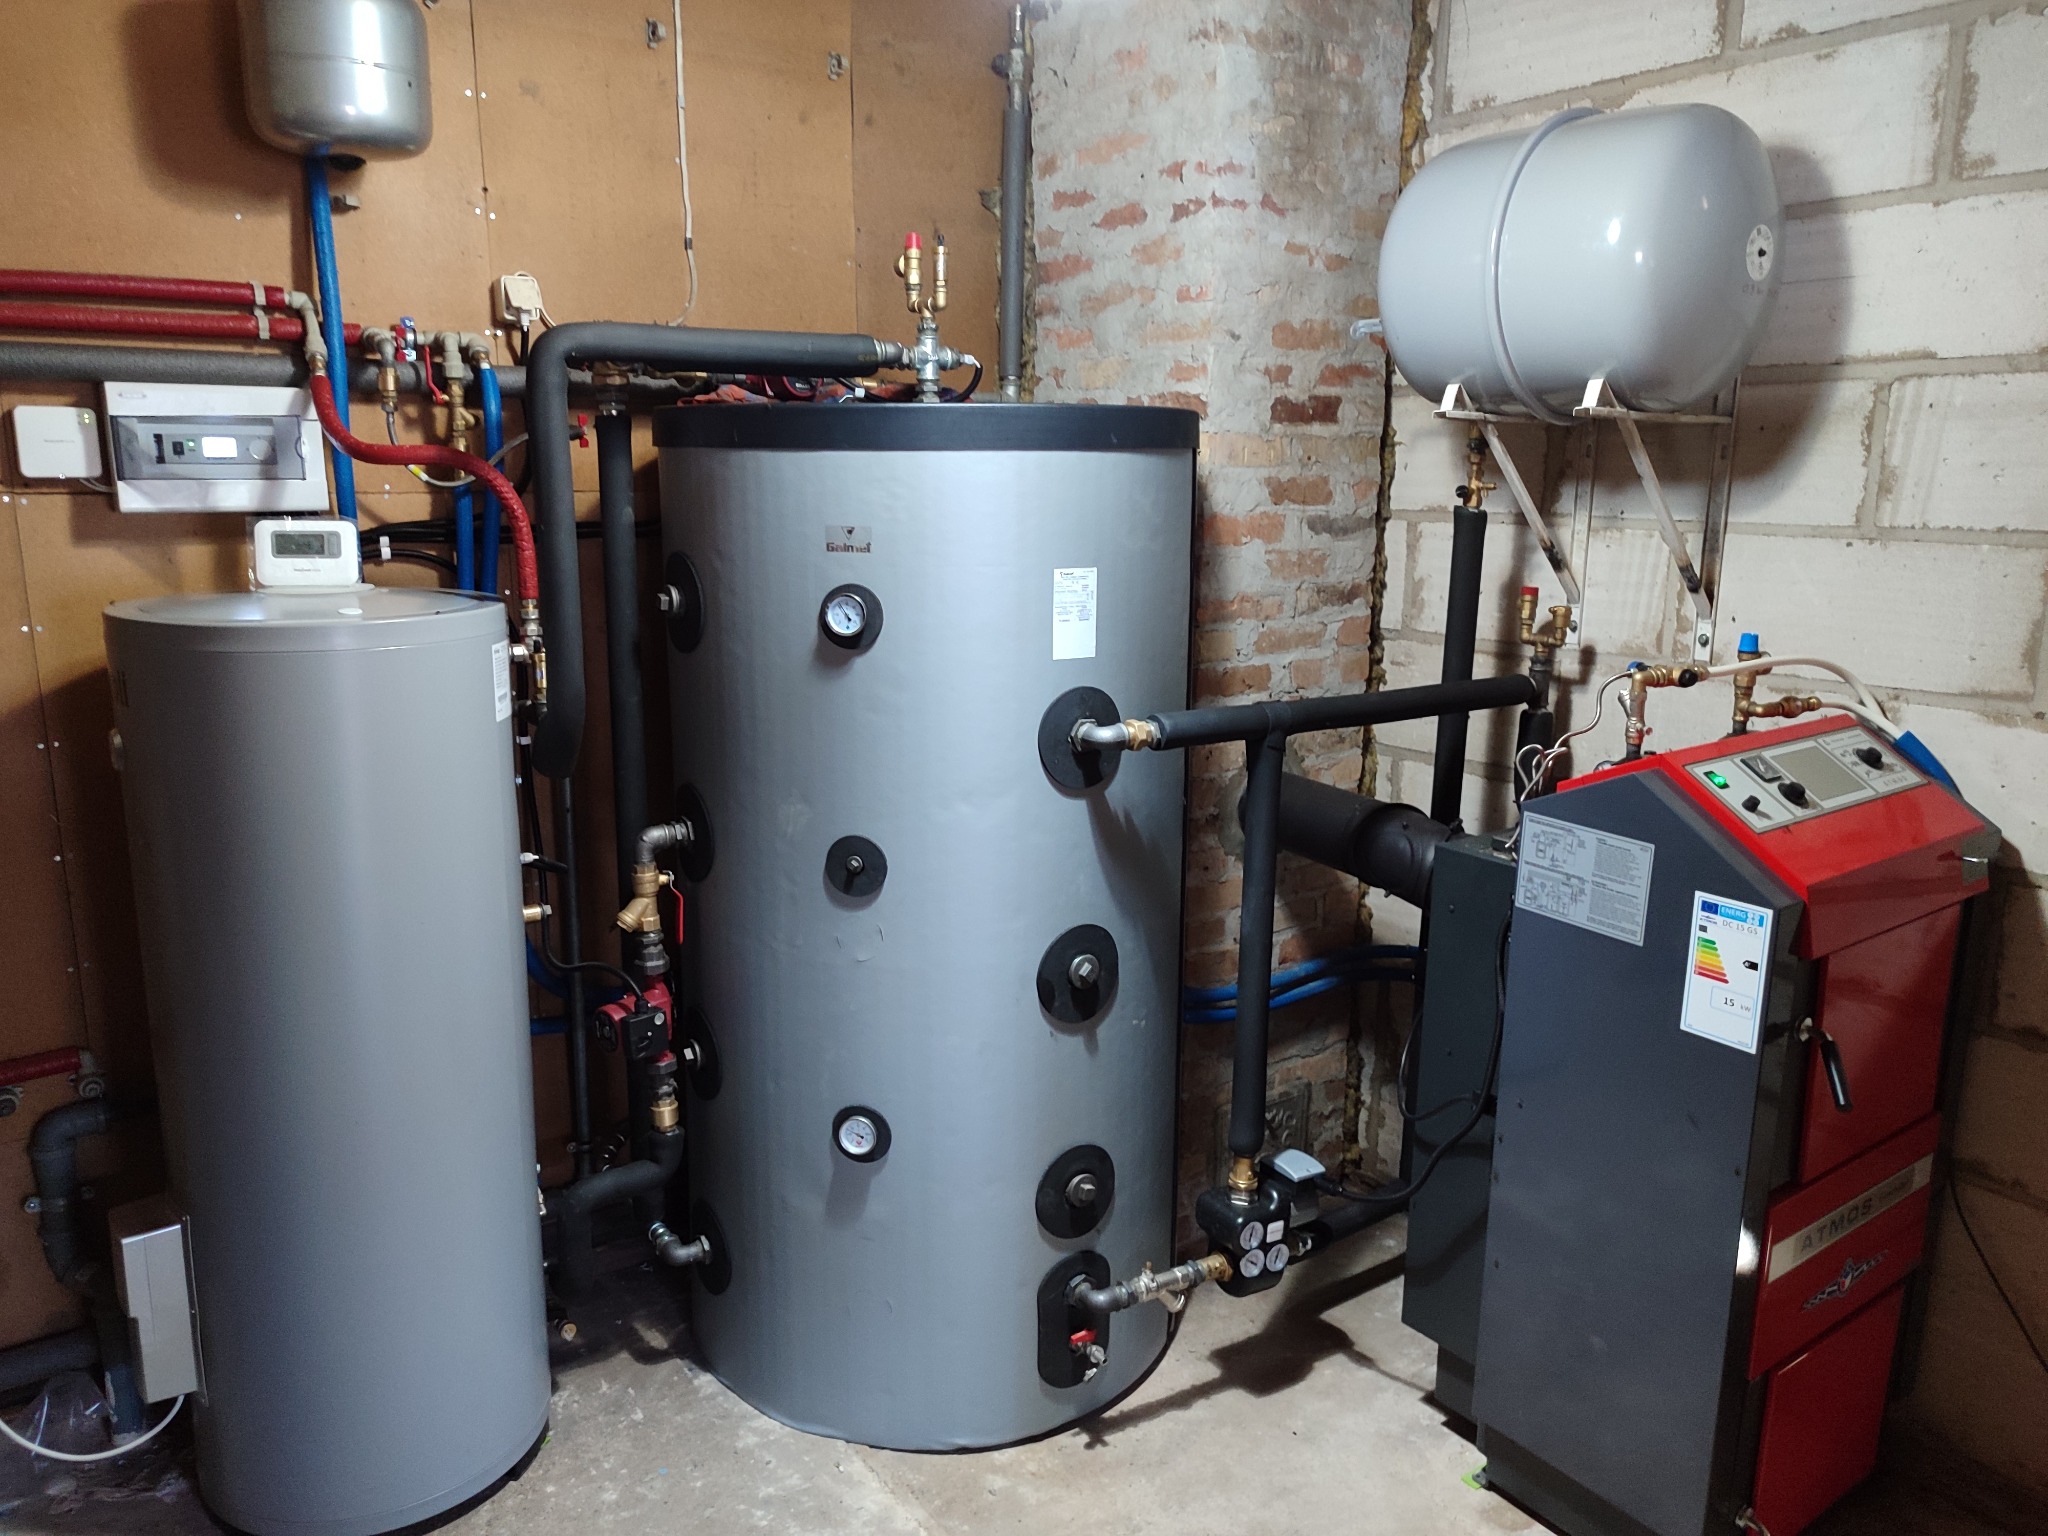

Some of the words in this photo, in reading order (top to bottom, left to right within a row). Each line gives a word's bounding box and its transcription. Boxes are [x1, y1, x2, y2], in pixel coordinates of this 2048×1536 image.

[1720, 905, 1747, 919] ENERG
[1722, 920, 1733, 929] DC
[1736, 923, 1745, 932] 15
[1747, 926, 1758, 935] GS
[1723, 997, 1735, 1007] 15
[1740, 1003, 1751, 1013] kW
[1800, 1197, 1873, 1252] ATMOS
